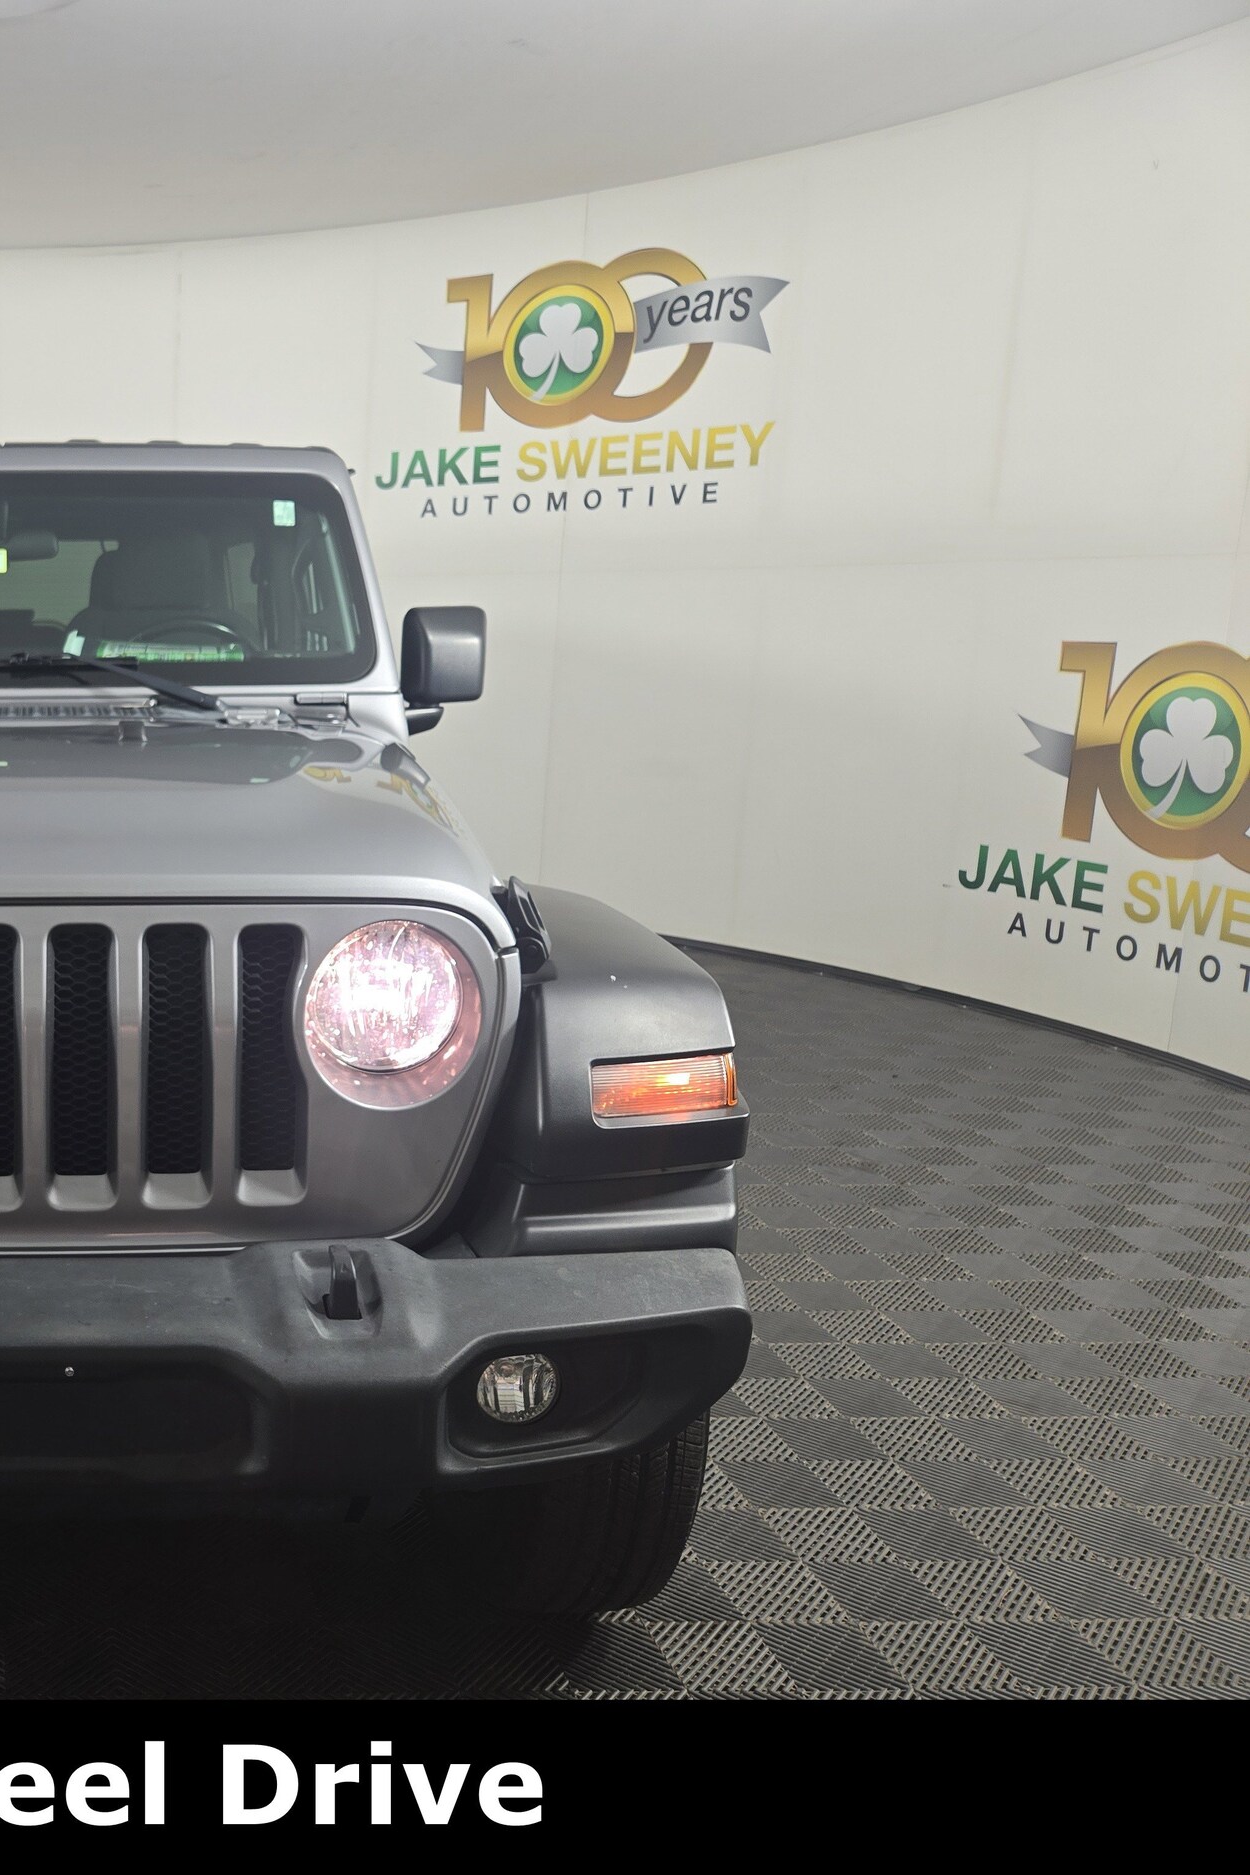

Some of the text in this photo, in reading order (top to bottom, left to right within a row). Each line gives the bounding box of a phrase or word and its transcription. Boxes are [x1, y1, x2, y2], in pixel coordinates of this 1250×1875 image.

[642, 284, 754, 344] years
[375, 420, 776, 490] JAKE SWEENEY
[421, 481, 718, 518] AUTOMOTIVE
[958, 844, 1109, 914] JAKE
